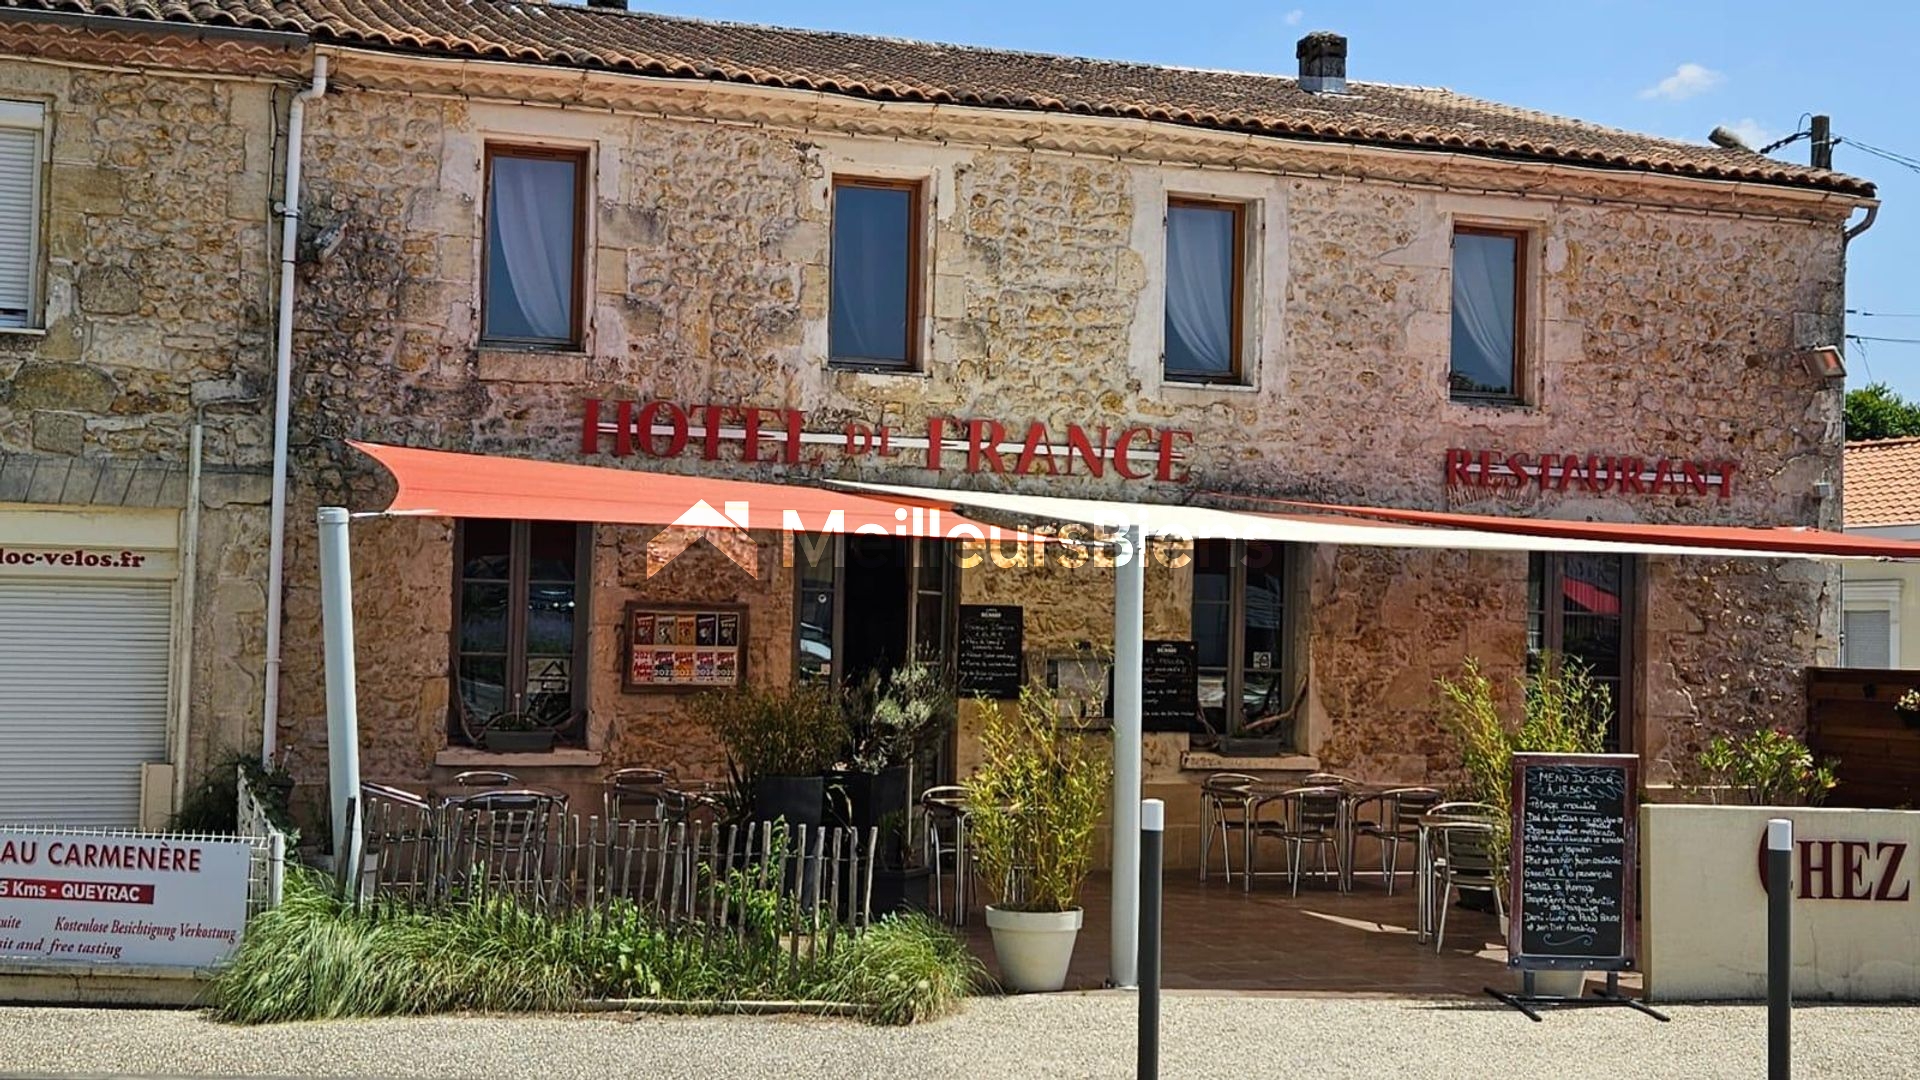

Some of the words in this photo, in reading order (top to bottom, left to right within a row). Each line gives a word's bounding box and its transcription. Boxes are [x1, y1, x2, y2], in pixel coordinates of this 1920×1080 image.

[844, 422, 901, 457] DE
[926, 415, 1194, 484] FRANCE
[1445, 448, 1737, 498] RESTAURANT
[0, 547, 145, 567] loc-velos.fr
[1539, 772, 1569, 784] MENU
[0, 840, 36, 865] AU
[48, 841, 201, 871] CARMENÈRE
[13, 881, 46, 898] Kms
[61, 884, 140, 902] QUEYRAC
[55, 916, 108, 933] Kostenlose
[111, 919, 177, 941] Besichtigung
[180, 922, 237, 945] Verkostung
[16, 937, 44, 951] and
[46, 938, 75, 956] free
[77, 942, 122, 959] tasting
